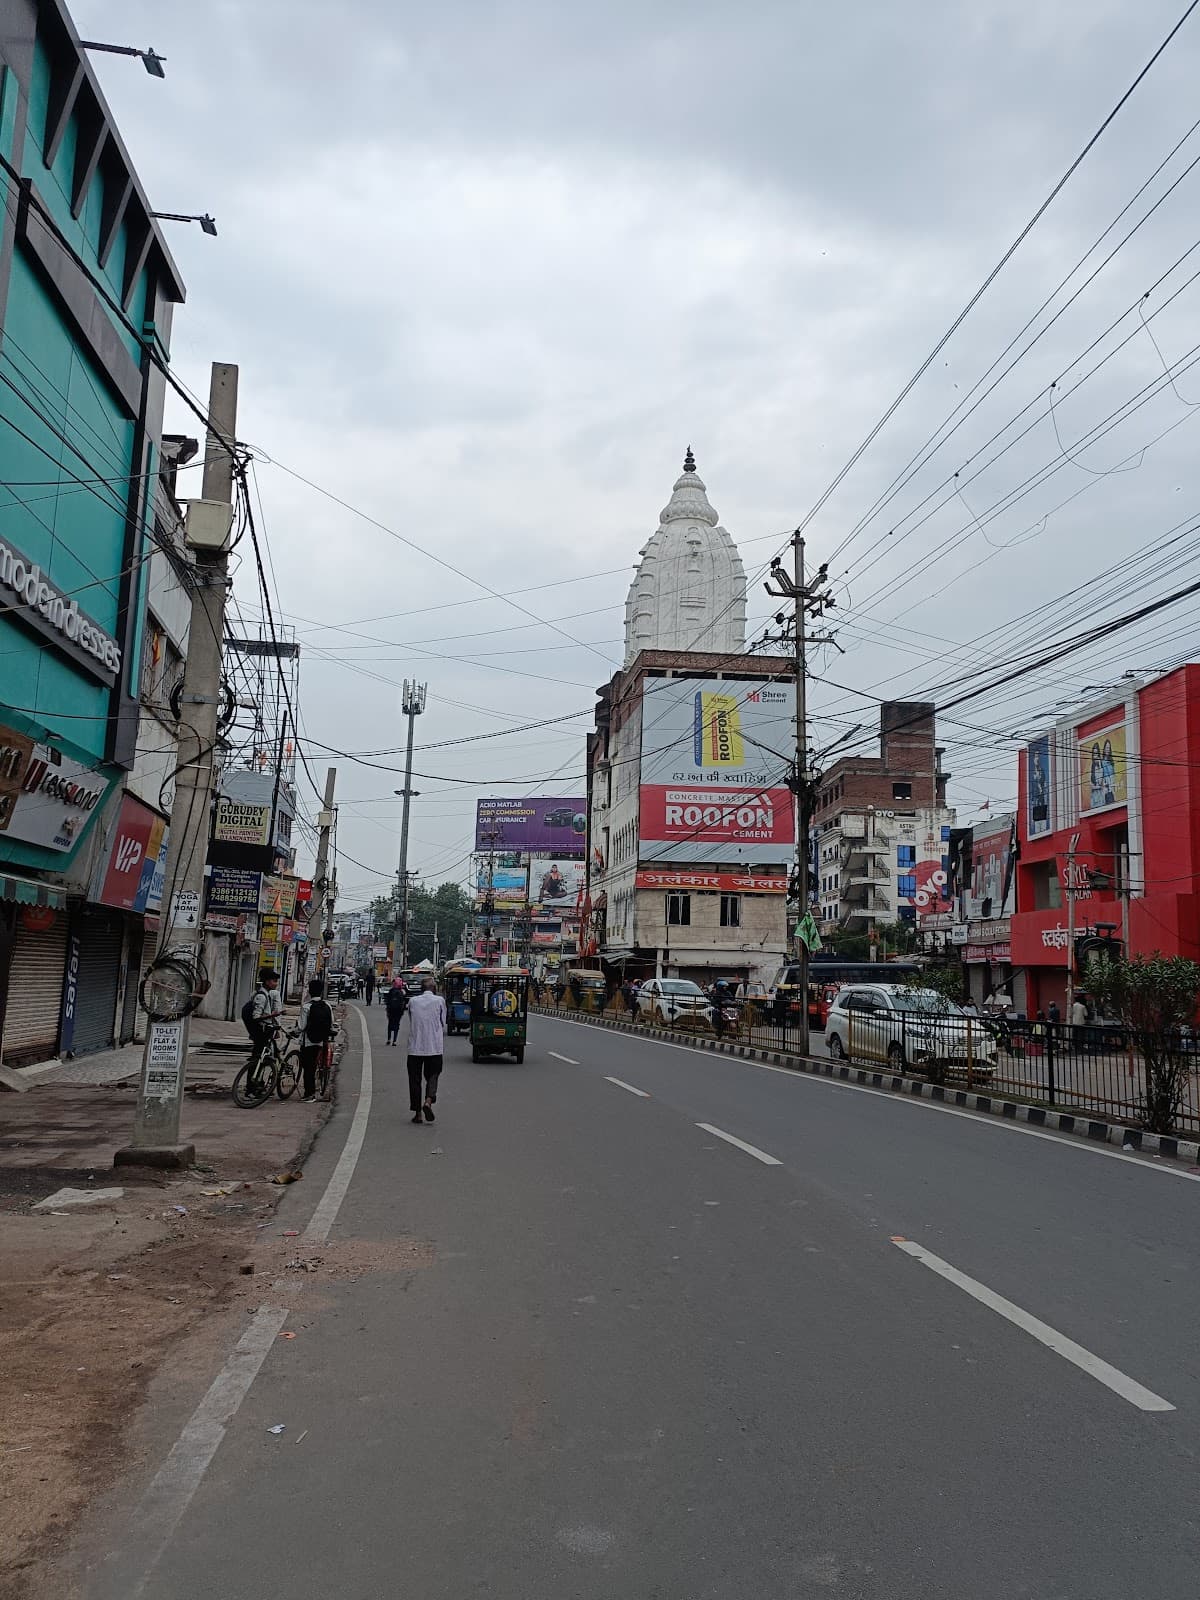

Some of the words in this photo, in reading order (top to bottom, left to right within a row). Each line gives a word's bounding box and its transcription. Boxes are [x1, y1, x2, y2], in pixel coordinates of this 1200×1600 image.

[762, 690, 788, 698] Shree
[717, 710, 731, 761] ROOFON
[706, 770, 719, 783] की
[668, 793, 713, 801] CONCRETE
[219, 803, 265, 817] GURUDEV
[665, 805, 774, 828] ROOFON
[875, 809, 895, 818] OYO
[219, 814, 264, 827] DIGITAL
[732, 829, 774, 838] CEMENT
[114, 834, 142, 873] VIP
[643, 872, 721, 887] अलंकार
[1063, 863, 1091, 886] SYLE
[914, 869, 948, 907] OYO
[175, 893, 198, 901] YOGA
[65, 935, 80, 1020] safari
[155, 1027, 178, 1035] TO-LET
